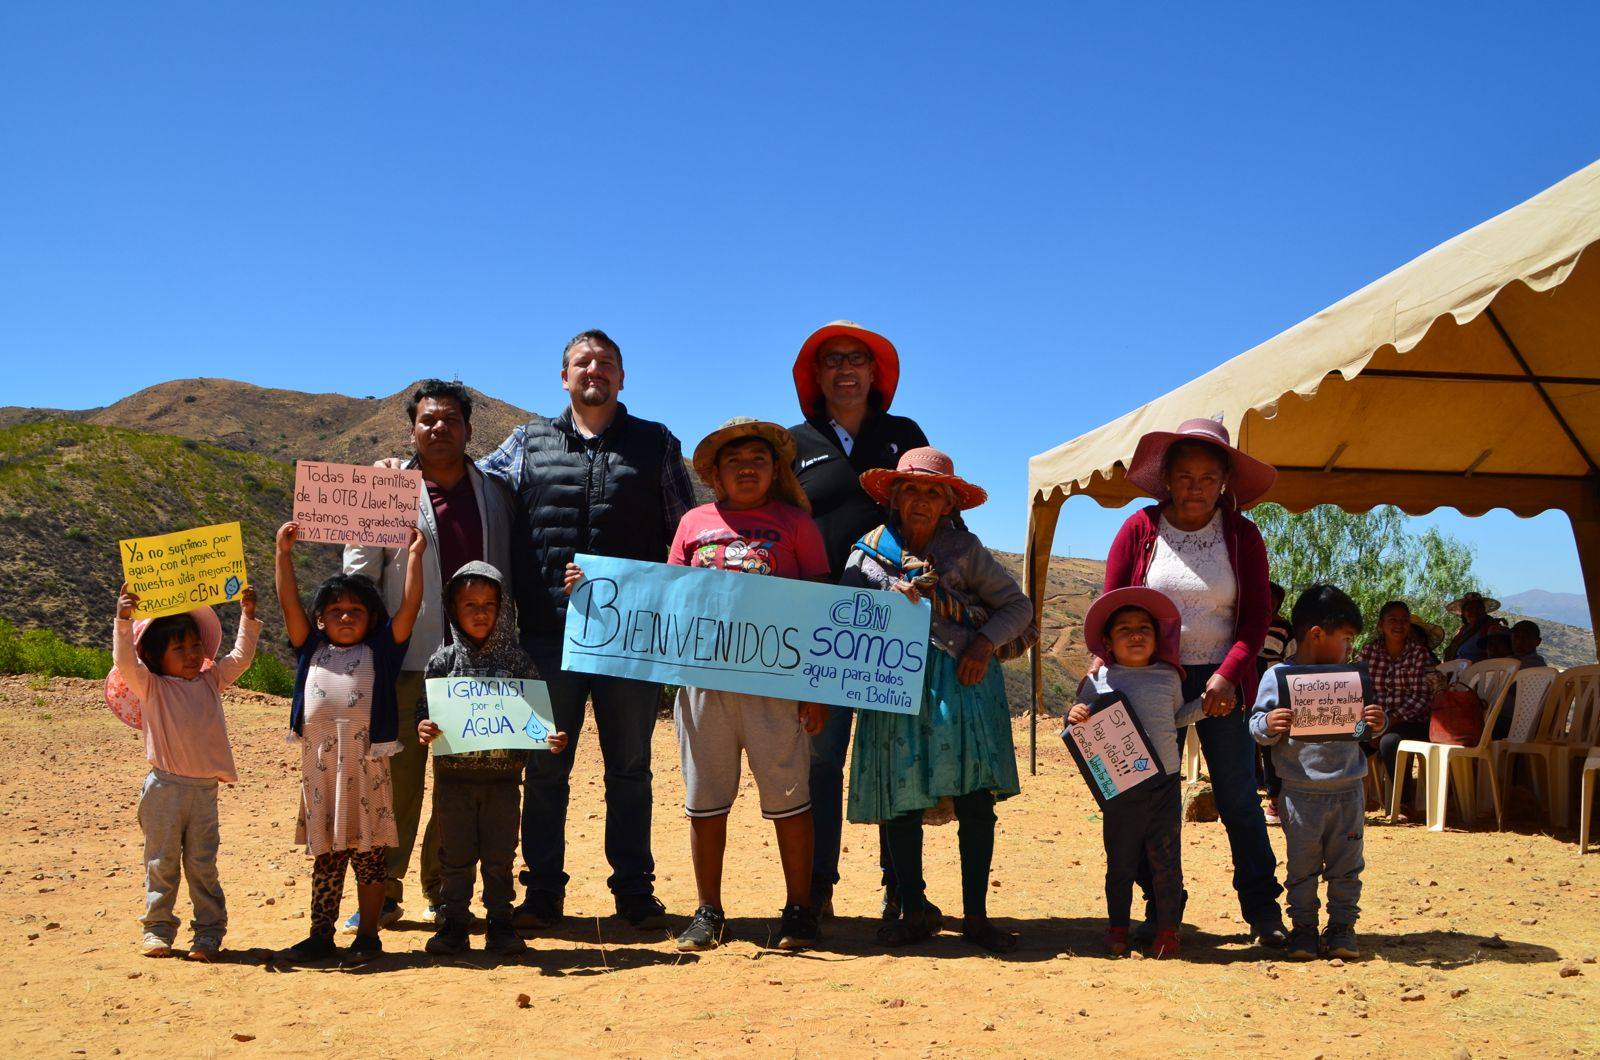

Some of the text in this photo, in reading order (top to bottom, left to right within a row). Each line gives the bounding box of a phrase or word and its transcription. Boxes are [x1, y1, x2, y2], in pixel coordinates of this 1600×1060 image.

[302, 465, 417, 490] Todas las familias
[296, 485, 311, 502] de
[318, 487, 328, 503] la
[332, 488, 358, 507] OTB
[361, 491, 387, 509] Llave
[297, 508, 417, 532] estamos agradecidos
[323, 528, 374, 542] TENEMOS
[125, 542, 143, 562] Ya
[148, 549, 164, 559] no
[213, 535, 232, 549] por
[128, 549, 226, 579] agua, con el proyecto
[133, 577, 175, 593] nuestra
[178, 571, 195, 585] vida
[189, 583, 219, 602] CBN
[829, 590, 892, 632] CBN
[569, 577, 801, 670] BIENVENIDOS
[803, 662, 904, 690] agua para todos
[1293, 677, 1350, 696] Gracias por
[447, 680, 526, 699] ¡GRACIAS!
[846, 686, 912, 708] en Bolivia
[1294, 691, 1363, 706] hacer esto realidad
[471, 699, 504, 717] por el
[462, 715, 515, 739] AGUA
[1072, 726, 1094, 759] Gracias
[1092, 719, 1131, 777] hay vida!!!
[1121, 731, 1139, 757] hay
